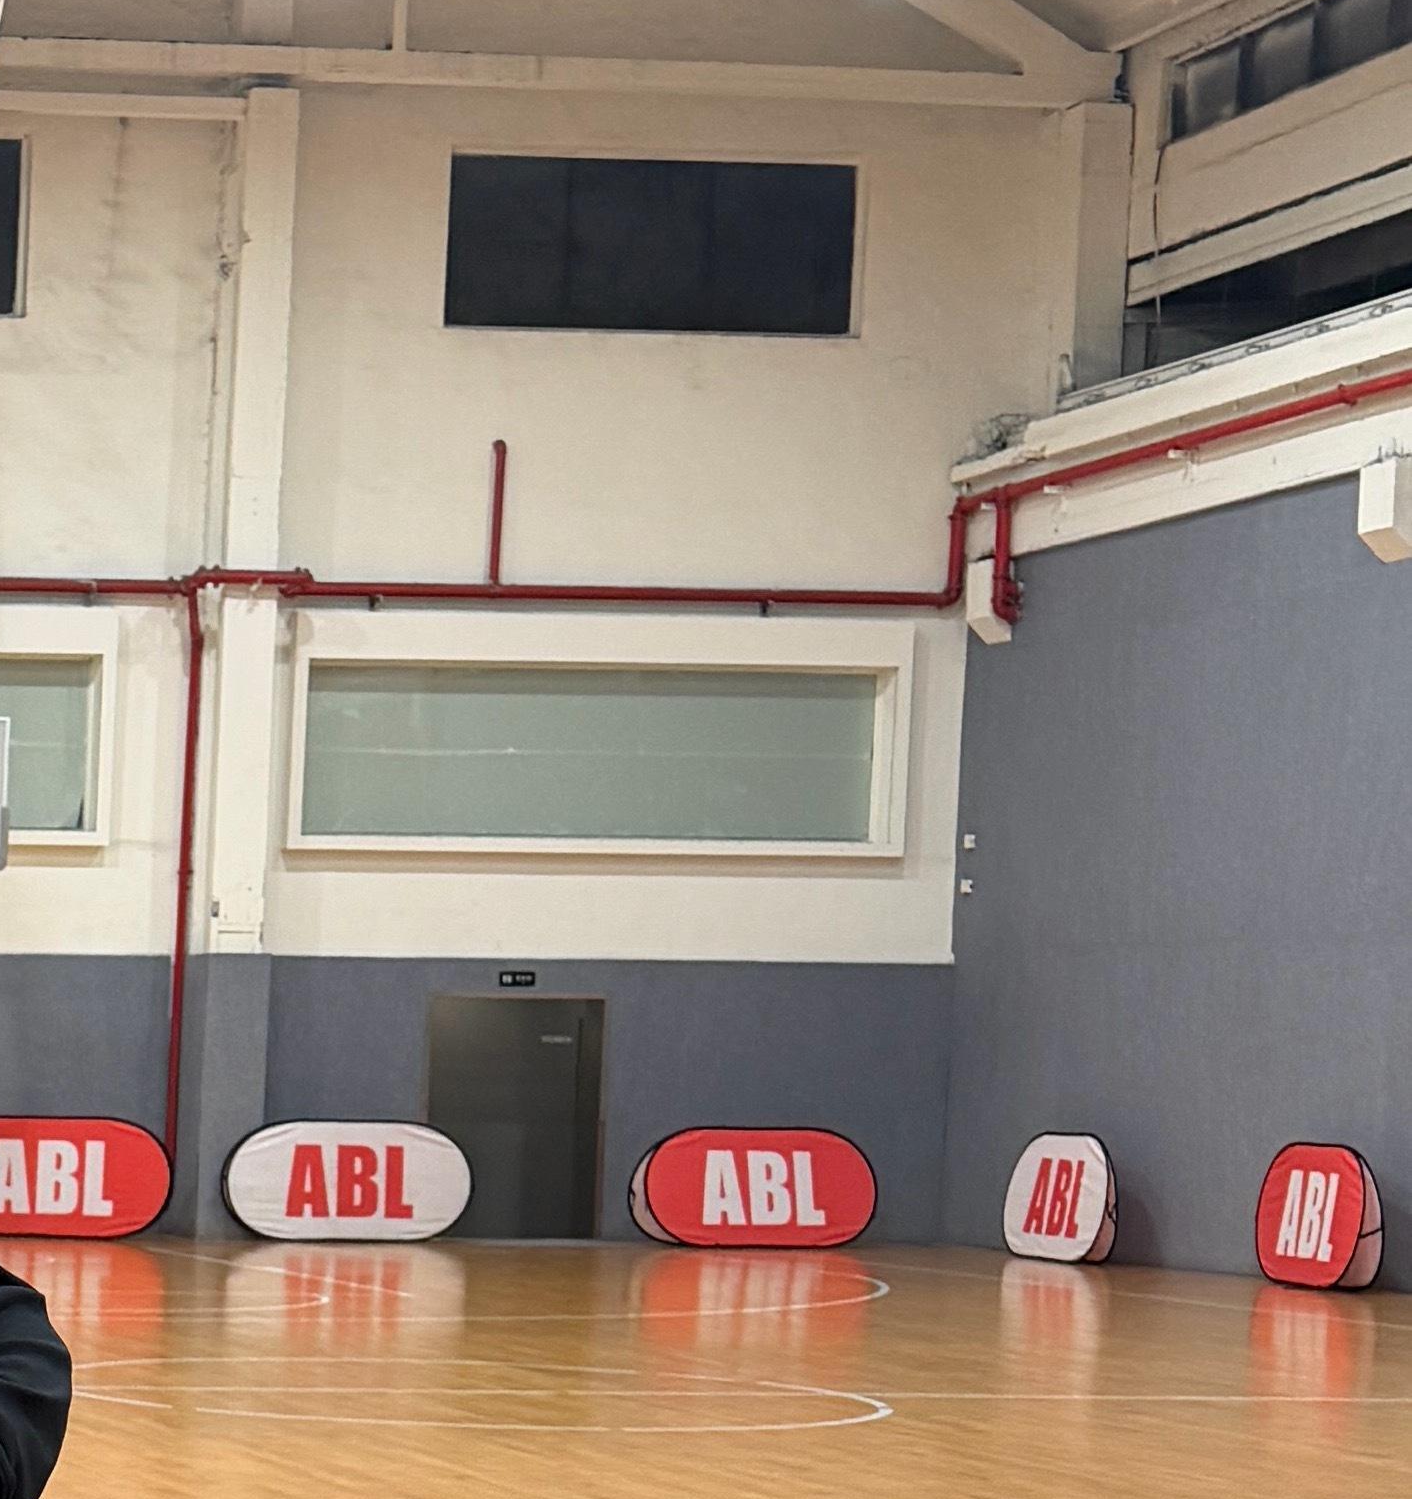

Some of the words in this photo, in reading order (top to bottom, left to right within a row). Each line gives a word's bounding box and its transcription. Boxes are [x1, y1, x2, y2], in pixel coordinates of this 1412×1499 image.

[286, 1144, 413, 1219] ABL
[702, 1149, 826, 1227] ABL
[1023, 1157, 1084, 1239] ABL
[1275, 1169, 1340, 1263] ABL
